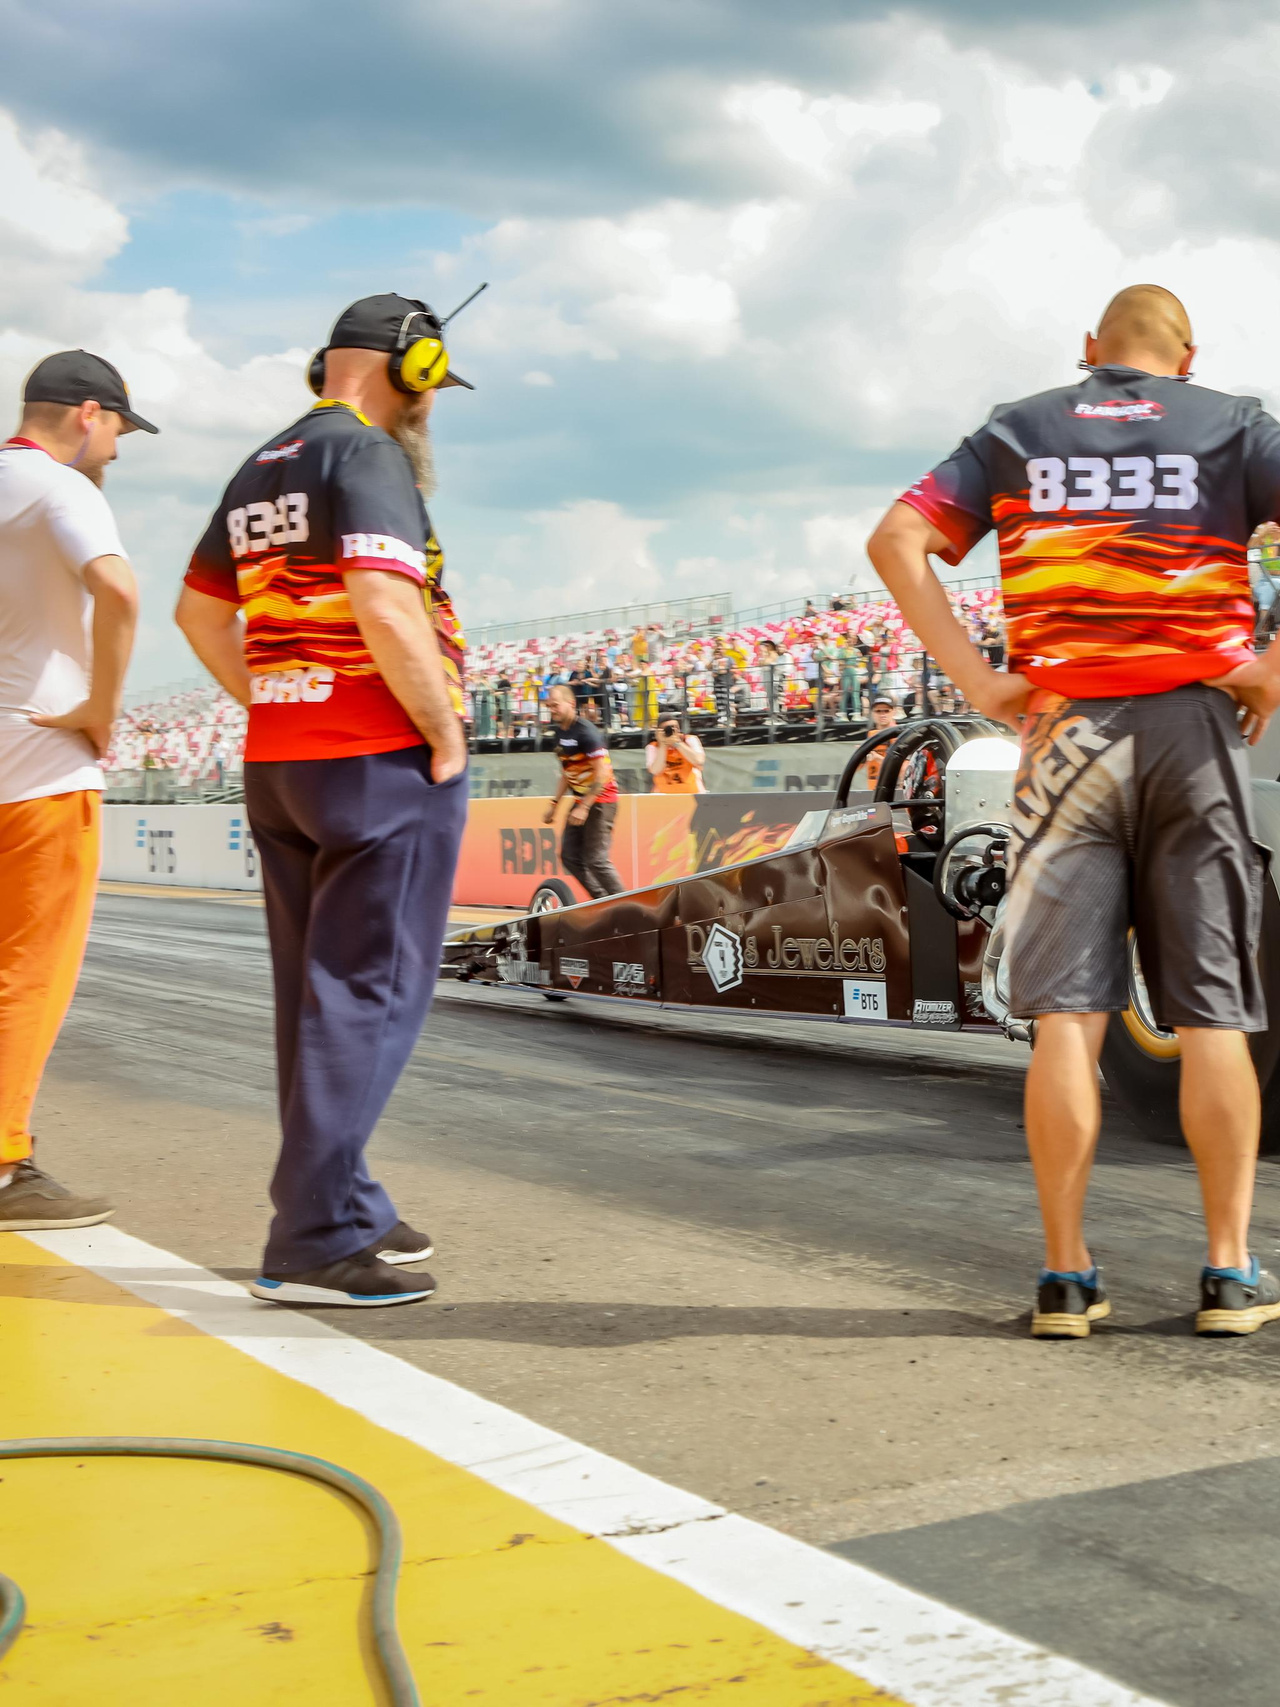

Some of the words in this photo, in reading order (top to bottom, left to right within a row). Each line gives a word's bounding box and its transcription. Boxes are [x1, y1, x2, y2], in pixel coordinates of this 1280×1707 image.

[1026, 454, 1199, 512] 8333
[501, 828, 572, 875] RDR
[767, 921, 887, 972] Jewelers
[861, 993, 879, 1011] ВТБ
